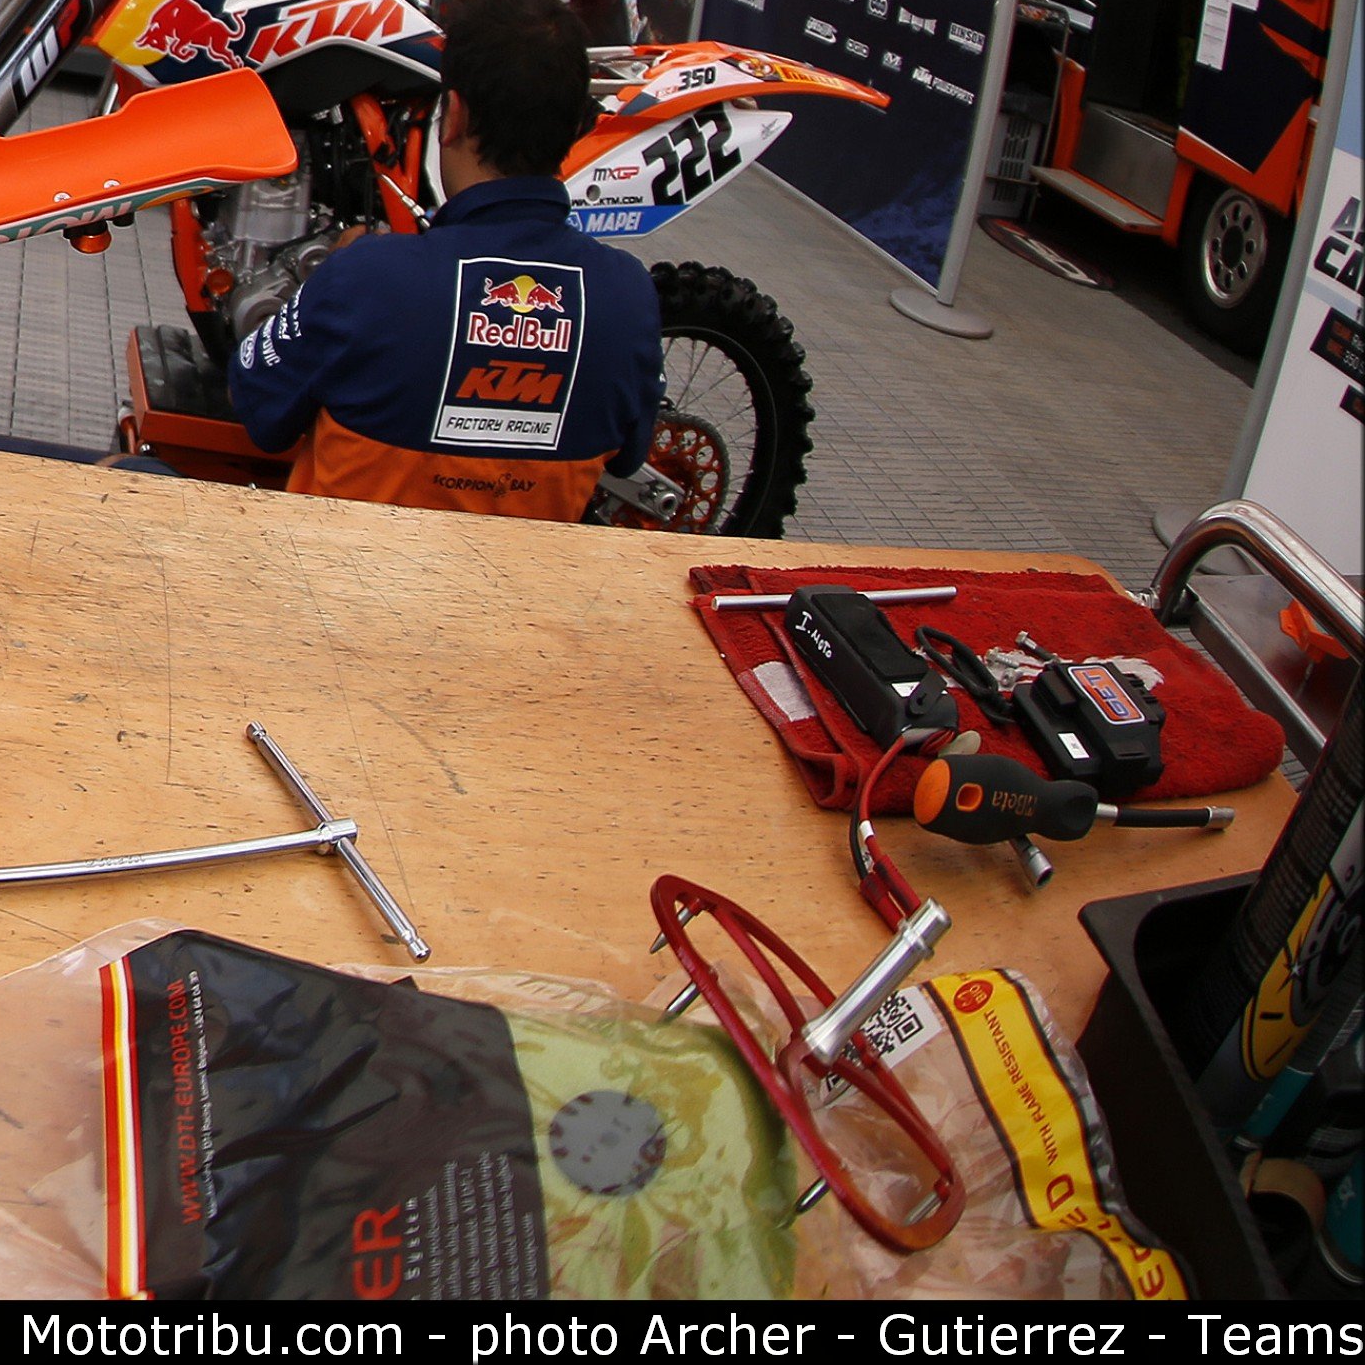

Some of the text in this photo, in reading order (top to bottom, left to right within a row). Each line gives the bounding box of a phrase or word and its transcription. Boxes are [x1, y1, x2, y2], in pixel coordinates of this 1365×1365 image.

[678, 66, 716, 91] 350
[592, 165, 640, 181] MXGP
[641, 102, 743, 206] 222
[585, 211, 643, 233] MAPEI
[467, 312, 572, 353] Red Bull
[455, 360, 564, 405] KTM
[445, 416, 552, 435] FACTORY RACING
[433, 474, 537, 493] SCORPION BAY
[1080, 670, 1131, 718] GET
[991, 790, 1028, 817] Beta
[167, 977, 203, 1225] WWW.DTI-EUROPE.COM
[983, 1007, 1059, 1167] WITH FLAME RESISTANT
[353, 1201, 403, 1300] ER
[404, 1196, 424, 1281] System
